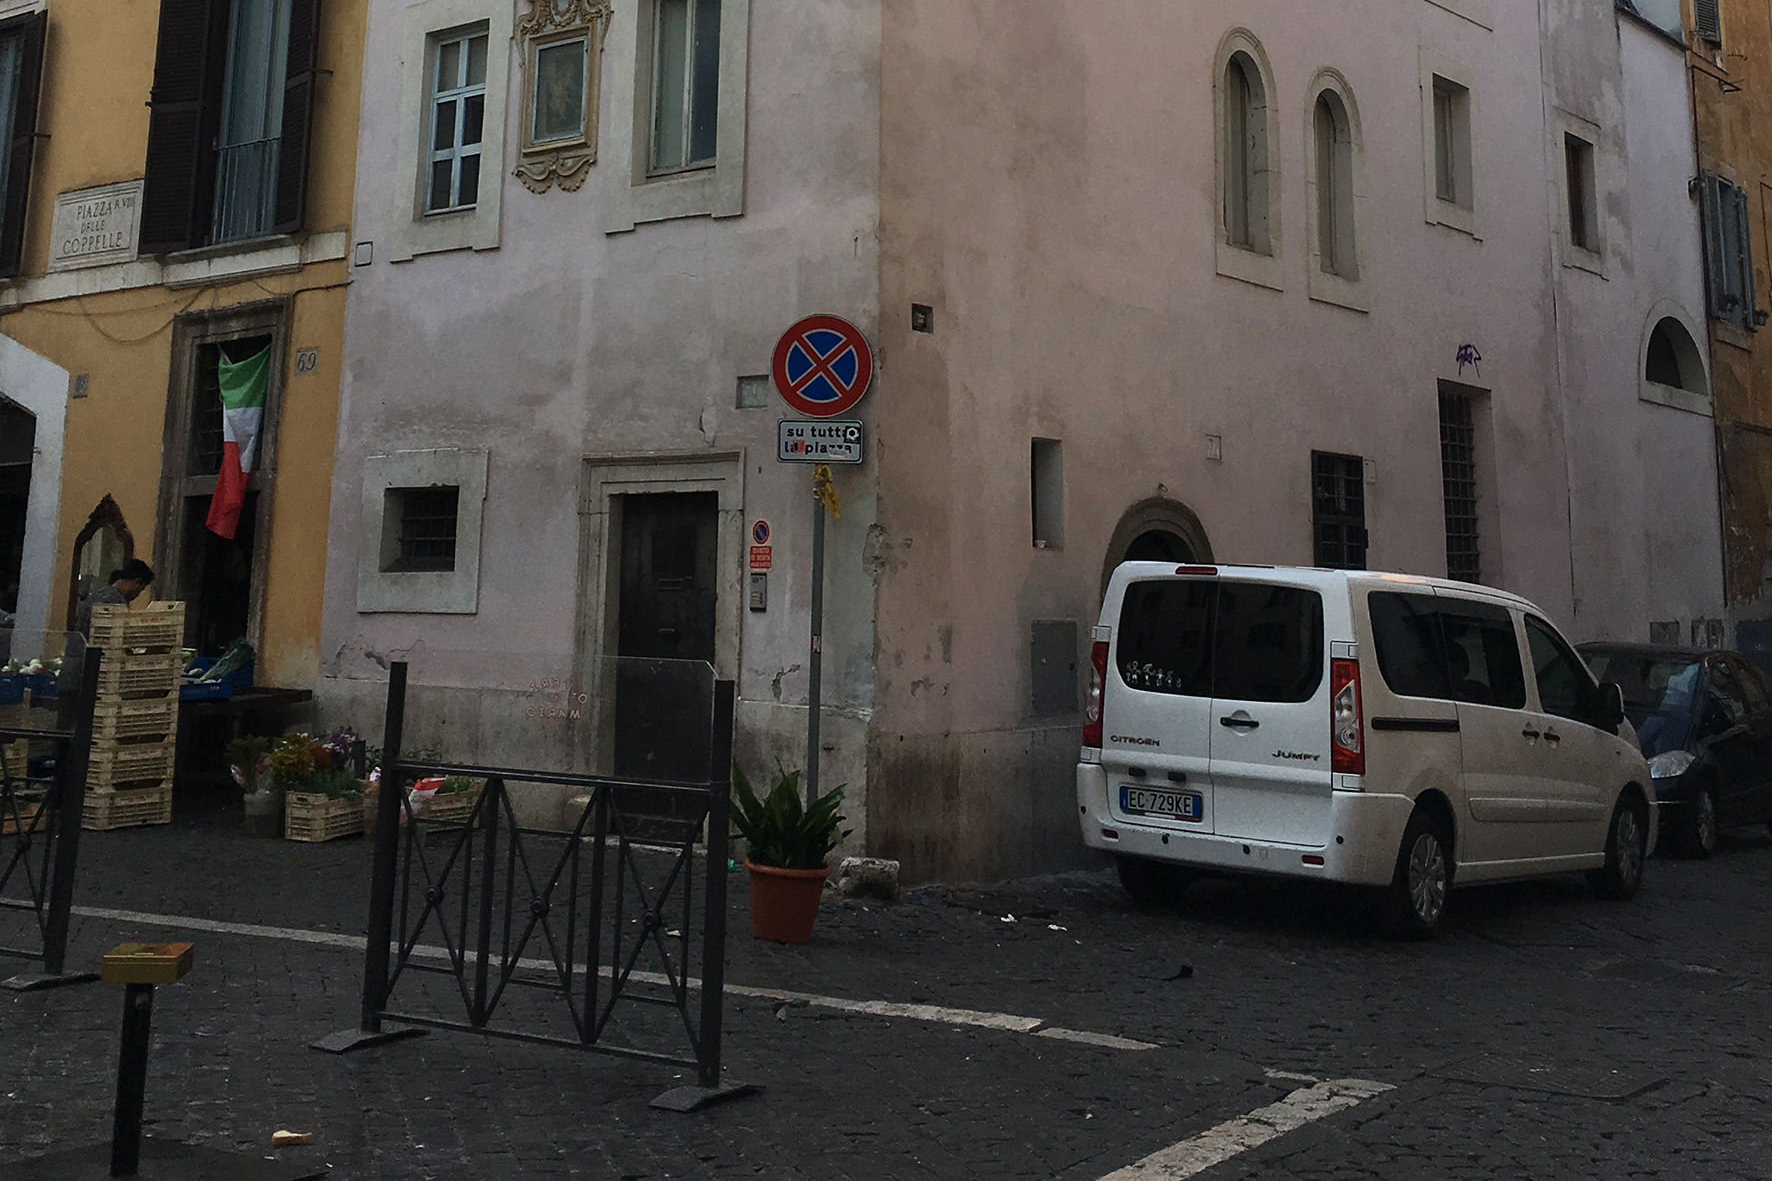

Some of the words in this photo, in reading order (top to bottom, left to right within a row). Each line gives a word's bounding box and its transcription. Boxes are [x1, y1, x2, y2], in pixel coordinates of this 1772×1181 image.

[77, 201, 112, 220] PIAZZA
[81, 220, 105, 234] DELLE
[63, 232, 122, 255] COPPELLE
[298, 352, 317, 372] 69
[787, 428, 804, 437] su
[1271, 749, 1321, 761] JUMPY
[1129, 791, 1145, 809] EC
[1149, 793, 1192, 814] 729KE
